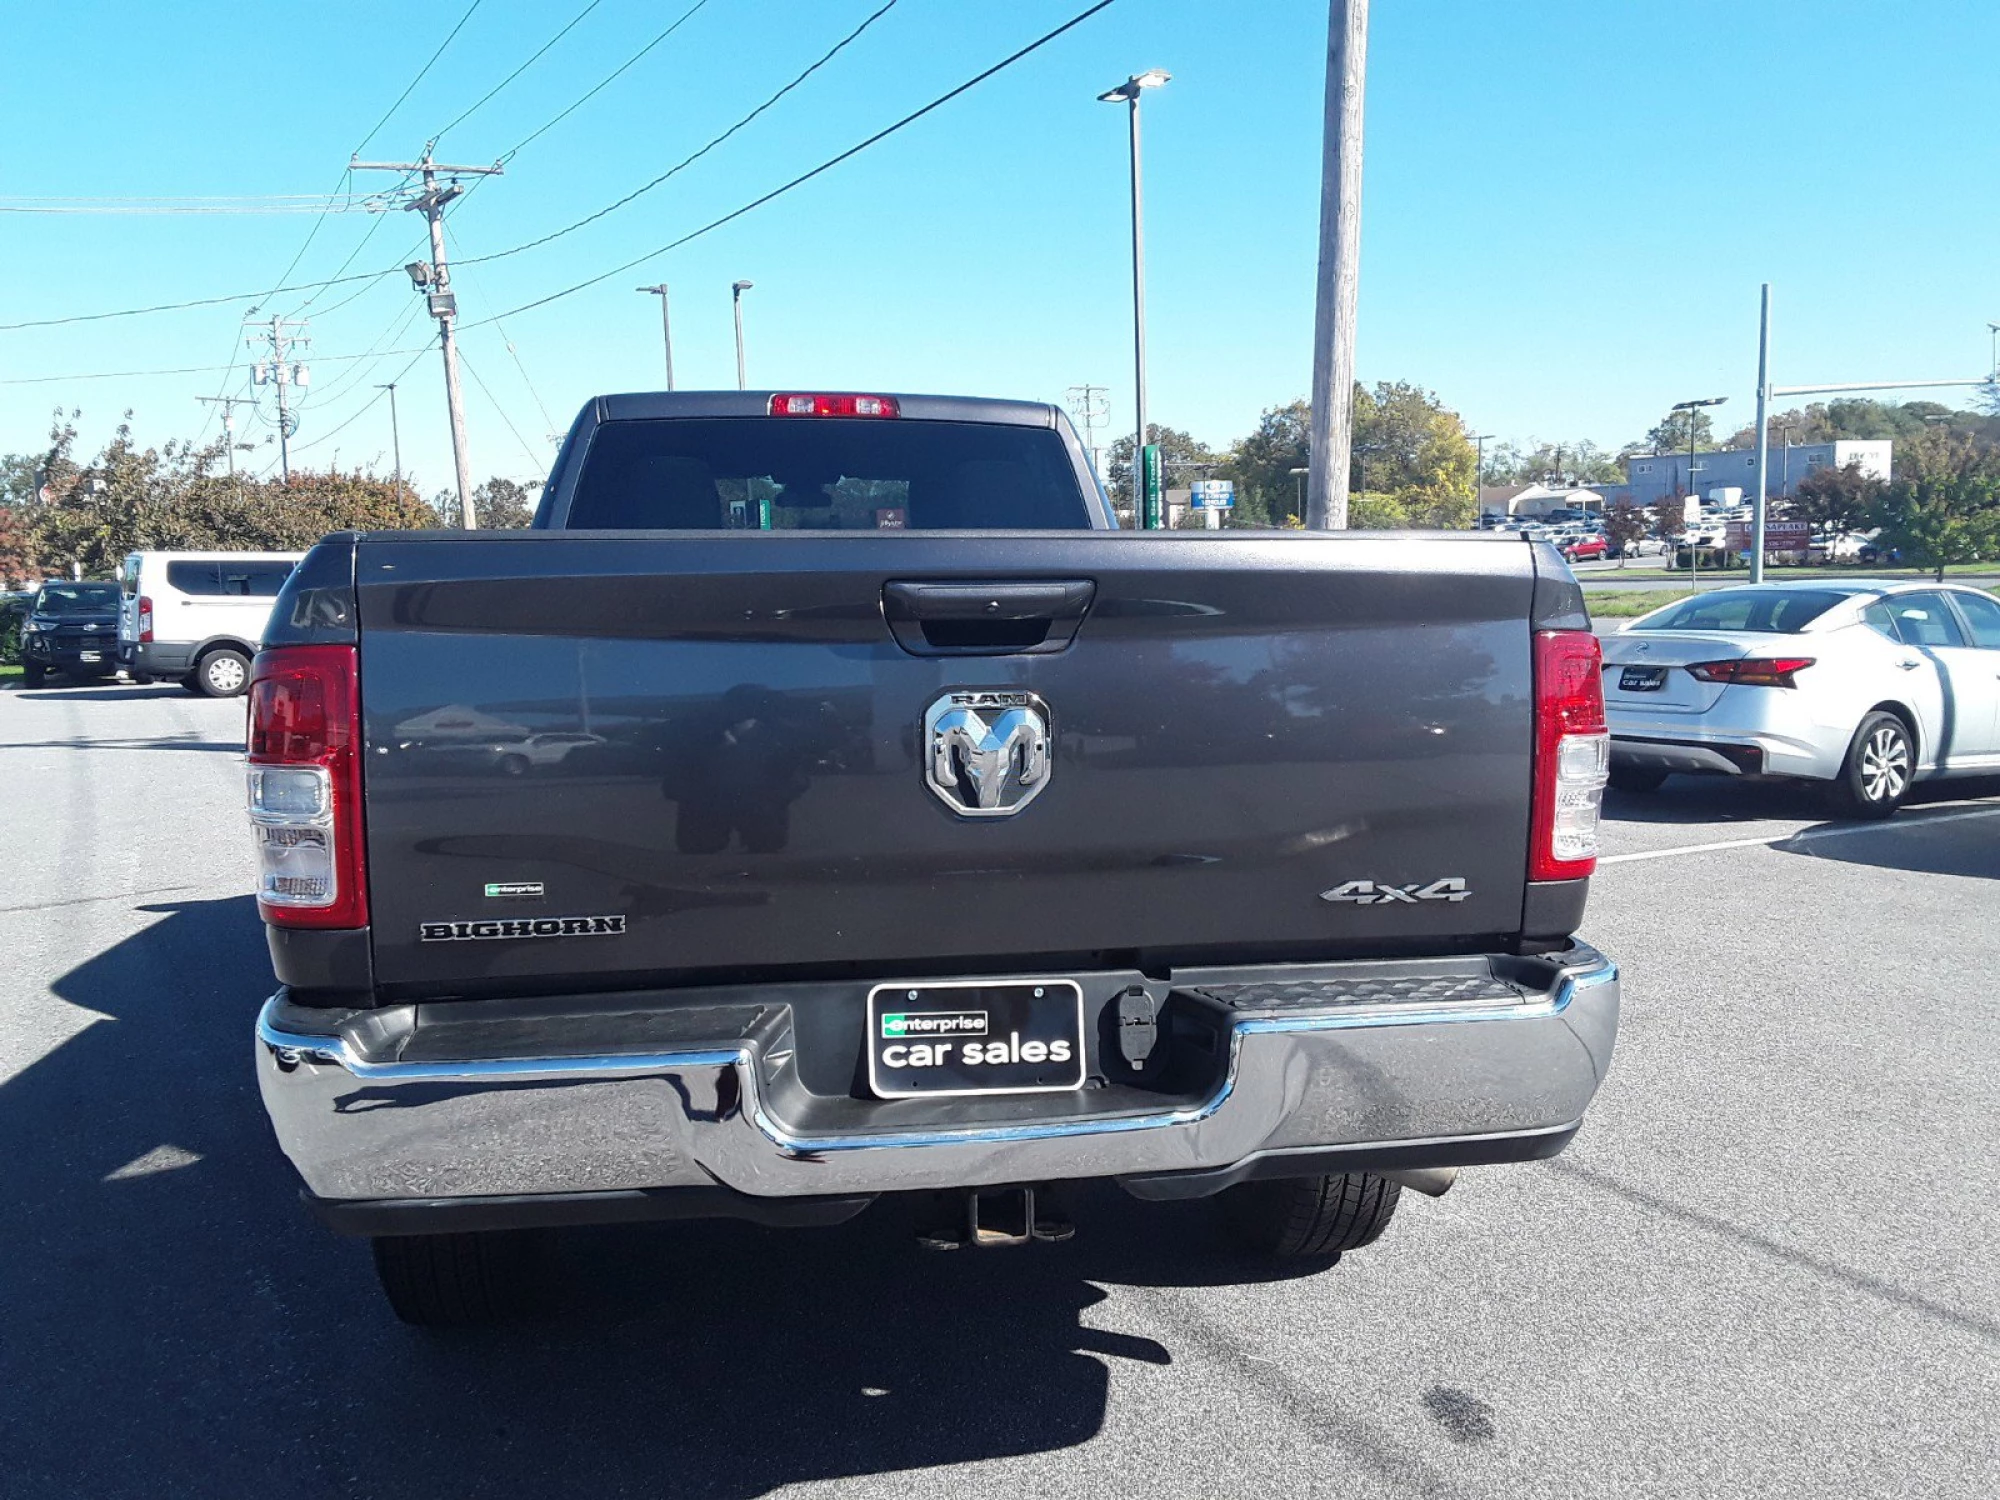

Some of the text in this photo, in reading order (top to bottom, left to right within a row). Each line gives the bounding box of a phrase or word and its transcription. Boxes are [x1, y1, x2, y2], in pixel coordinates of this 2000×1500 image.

[950, 693, 1027, 706] RAM
[487, 883, 543, 894] enterprise
[421, 915, 626, 941] BIGHORN
[884, 1012, 986, 1033] enterprise
[882, 1031, 1071, 1068] car sales
